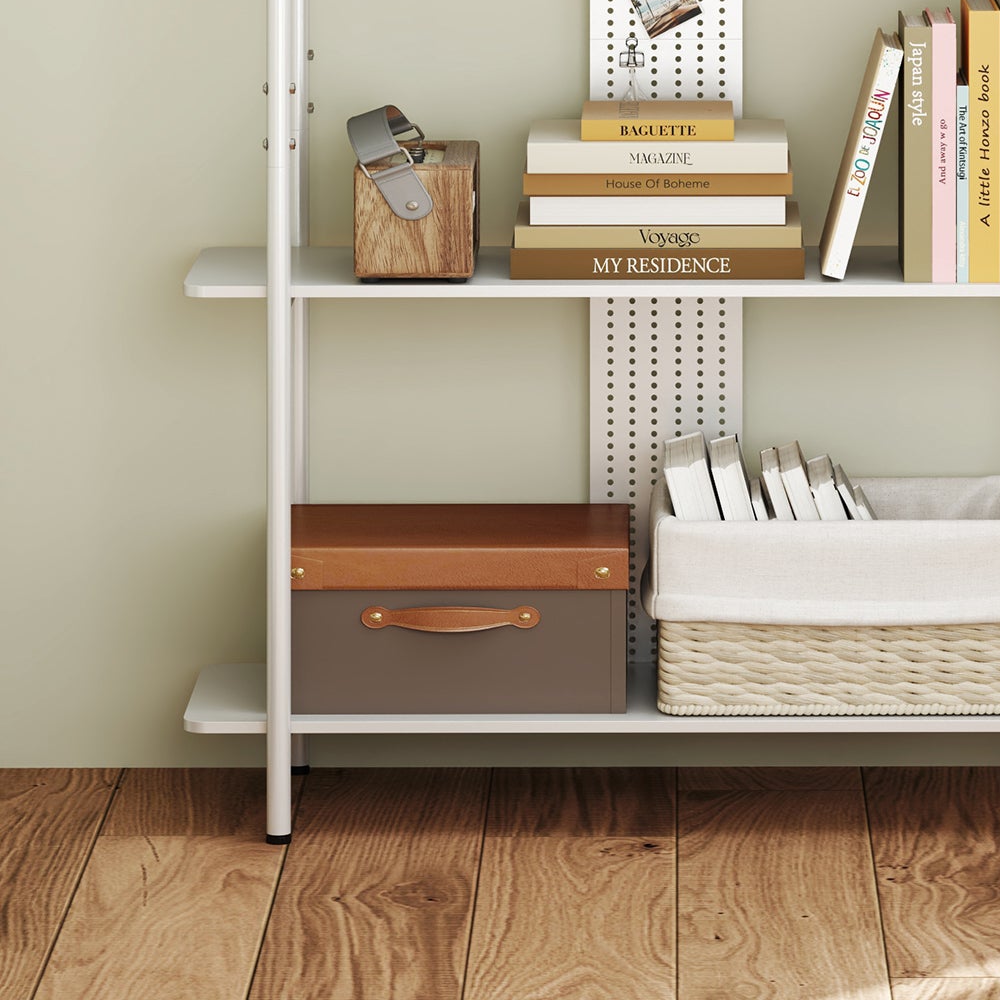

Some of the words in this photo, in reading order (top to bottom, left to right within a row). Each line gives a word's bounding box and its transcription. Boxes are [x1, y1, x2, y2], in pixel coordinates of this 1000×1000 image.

[907, 42, 926, 86] Japan
[978, 64, 990, 102] book
[907, 90, 927, 126] style
[959, 106, 967, 121] The
[620, 125, 697, 137] BAGUETTE
[940, 118, 948, 130] go
[959, 122, 967, 135] Art
[959, 136, 967, 145] of
[979, 109, 990, 160] Honzo
[629, 152, 693, 166] MAGAZINE
[940, 141, 948, 163] away
[847, 187, 860, 197] EL
[859, 145, 870, 155] DE
[956, 146, 967, 180] Kintsugi
[606, 179, 642, 189] House
[645, 178, 660, 189] Of
[663, 178, 710, 189] Boheme
[938, 166, 946, 185] And
[978, 168, 990, 206] little
[980, 213, 991, 227] A
[639, 229, 701, 248] Voyage
[593, 257, 622, 274] MY
[626, 257, 731, 274] RESIDENCE
